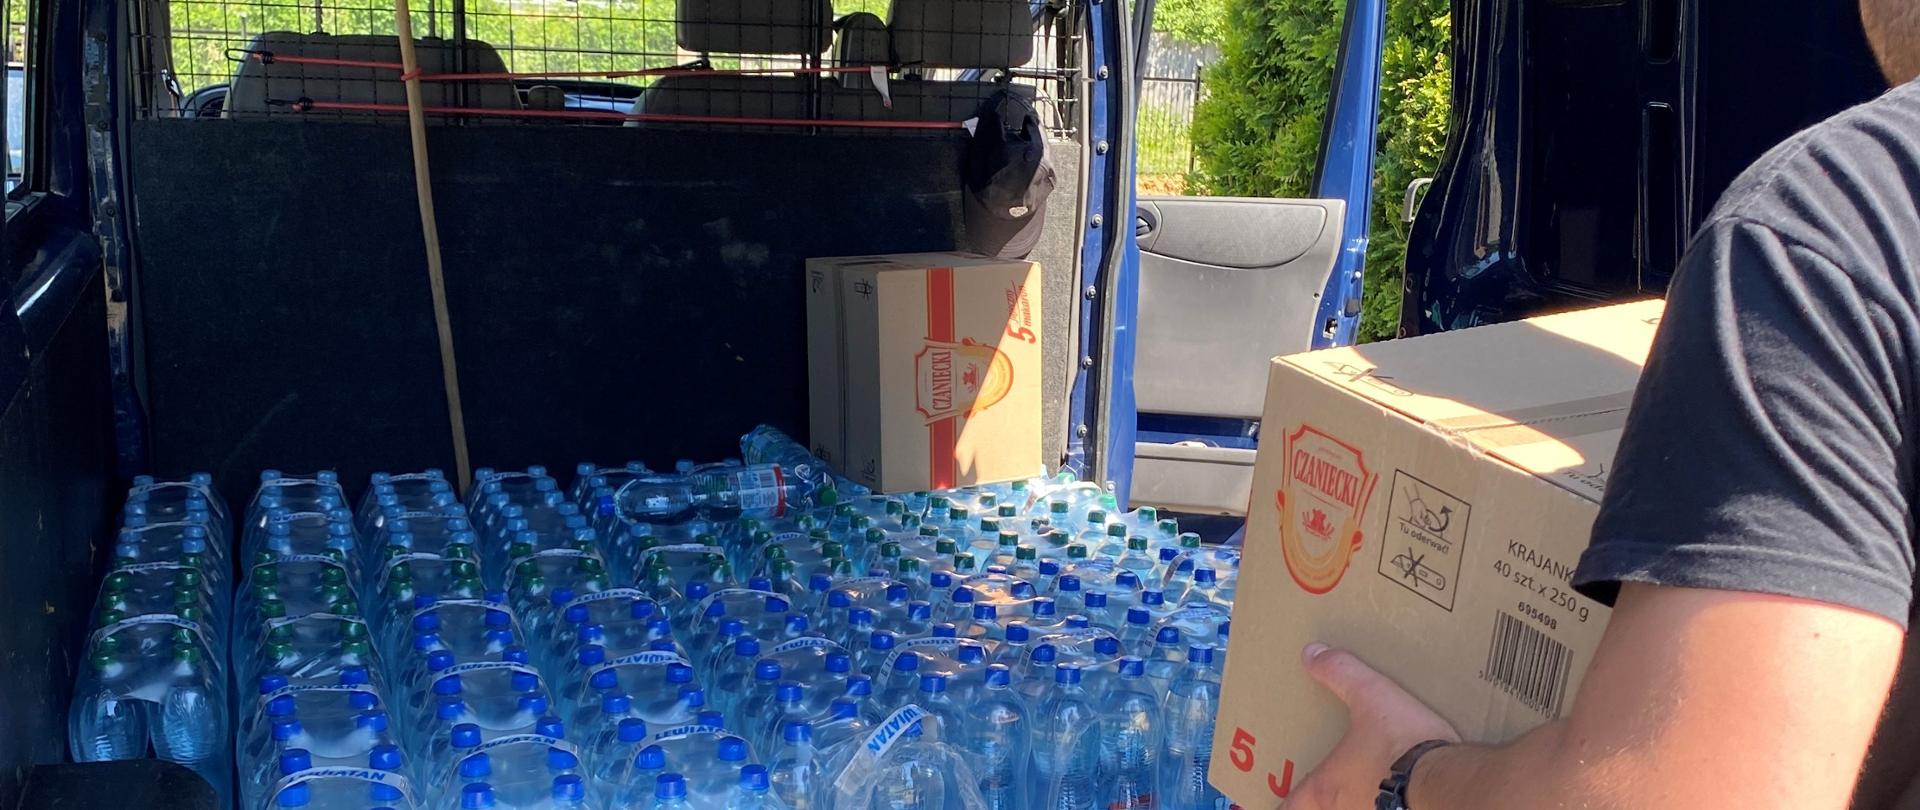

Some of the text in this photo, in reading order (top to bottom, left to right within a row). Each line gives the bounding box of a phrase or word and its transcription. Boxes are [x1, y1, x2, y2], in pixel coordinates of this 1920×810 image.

[1005, 324, 1036, 344] 5
[931, 351, 952, 411] CZANIECKI
[1293, 449, 1360, 508] CZANIECKI
[1400, 521, 1410, 534] Tu
[1493, 559, 1590, 623] 40 szt. x 250 g
[1517, 601, 1558, 630] 695498
[1229, 727, 1294, 799] 5 J
